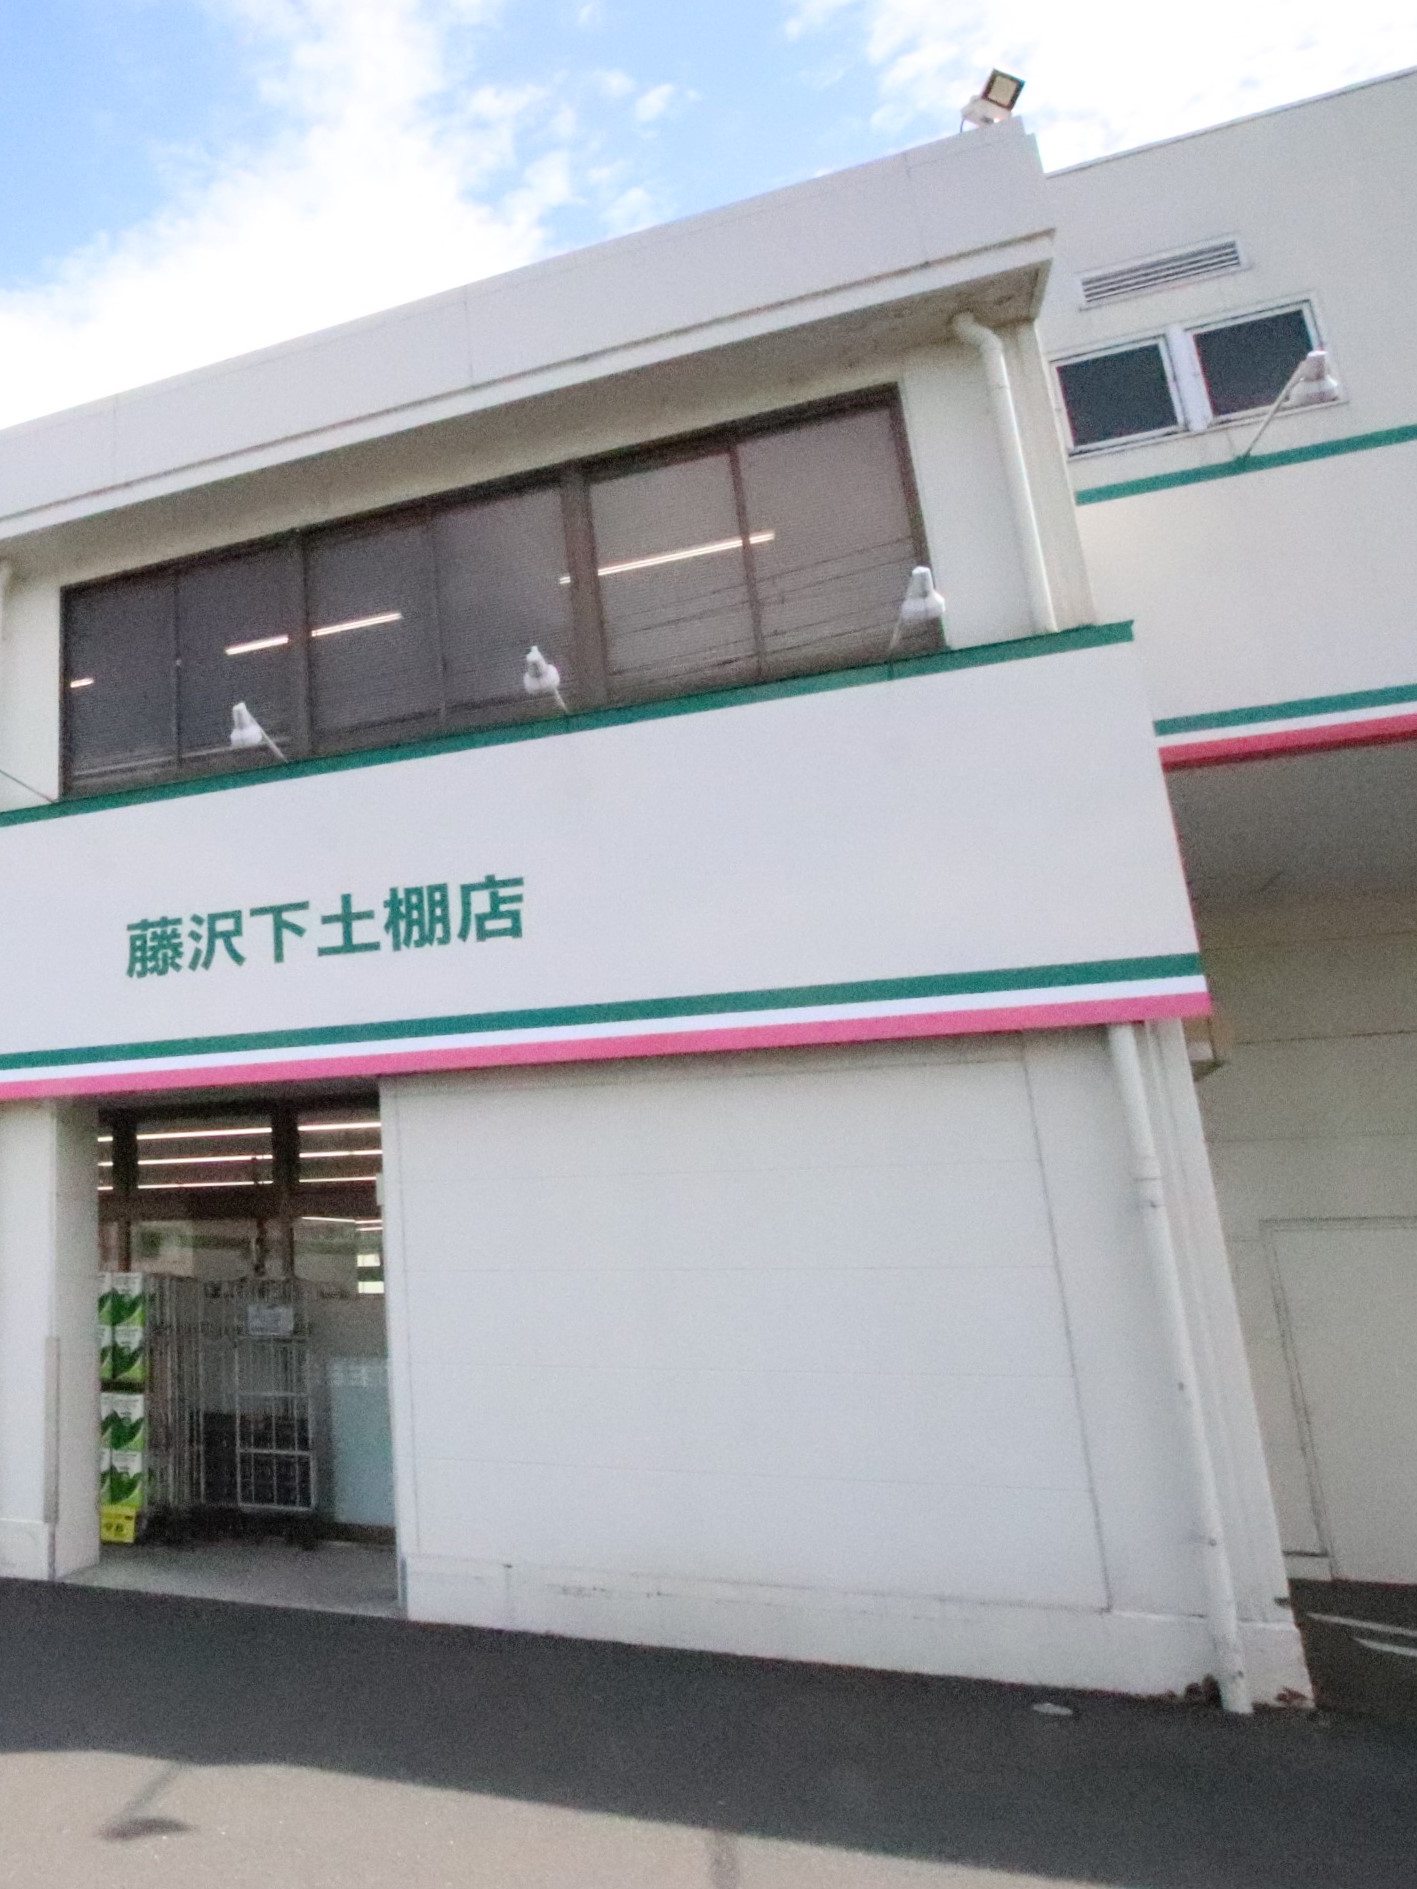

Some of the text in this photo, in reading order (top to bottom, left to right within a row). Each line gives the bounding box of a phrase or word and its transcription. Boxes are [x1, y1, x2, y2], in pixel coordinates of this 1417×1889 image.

[125, 874, 525, 979] 藤沢下土棚店
